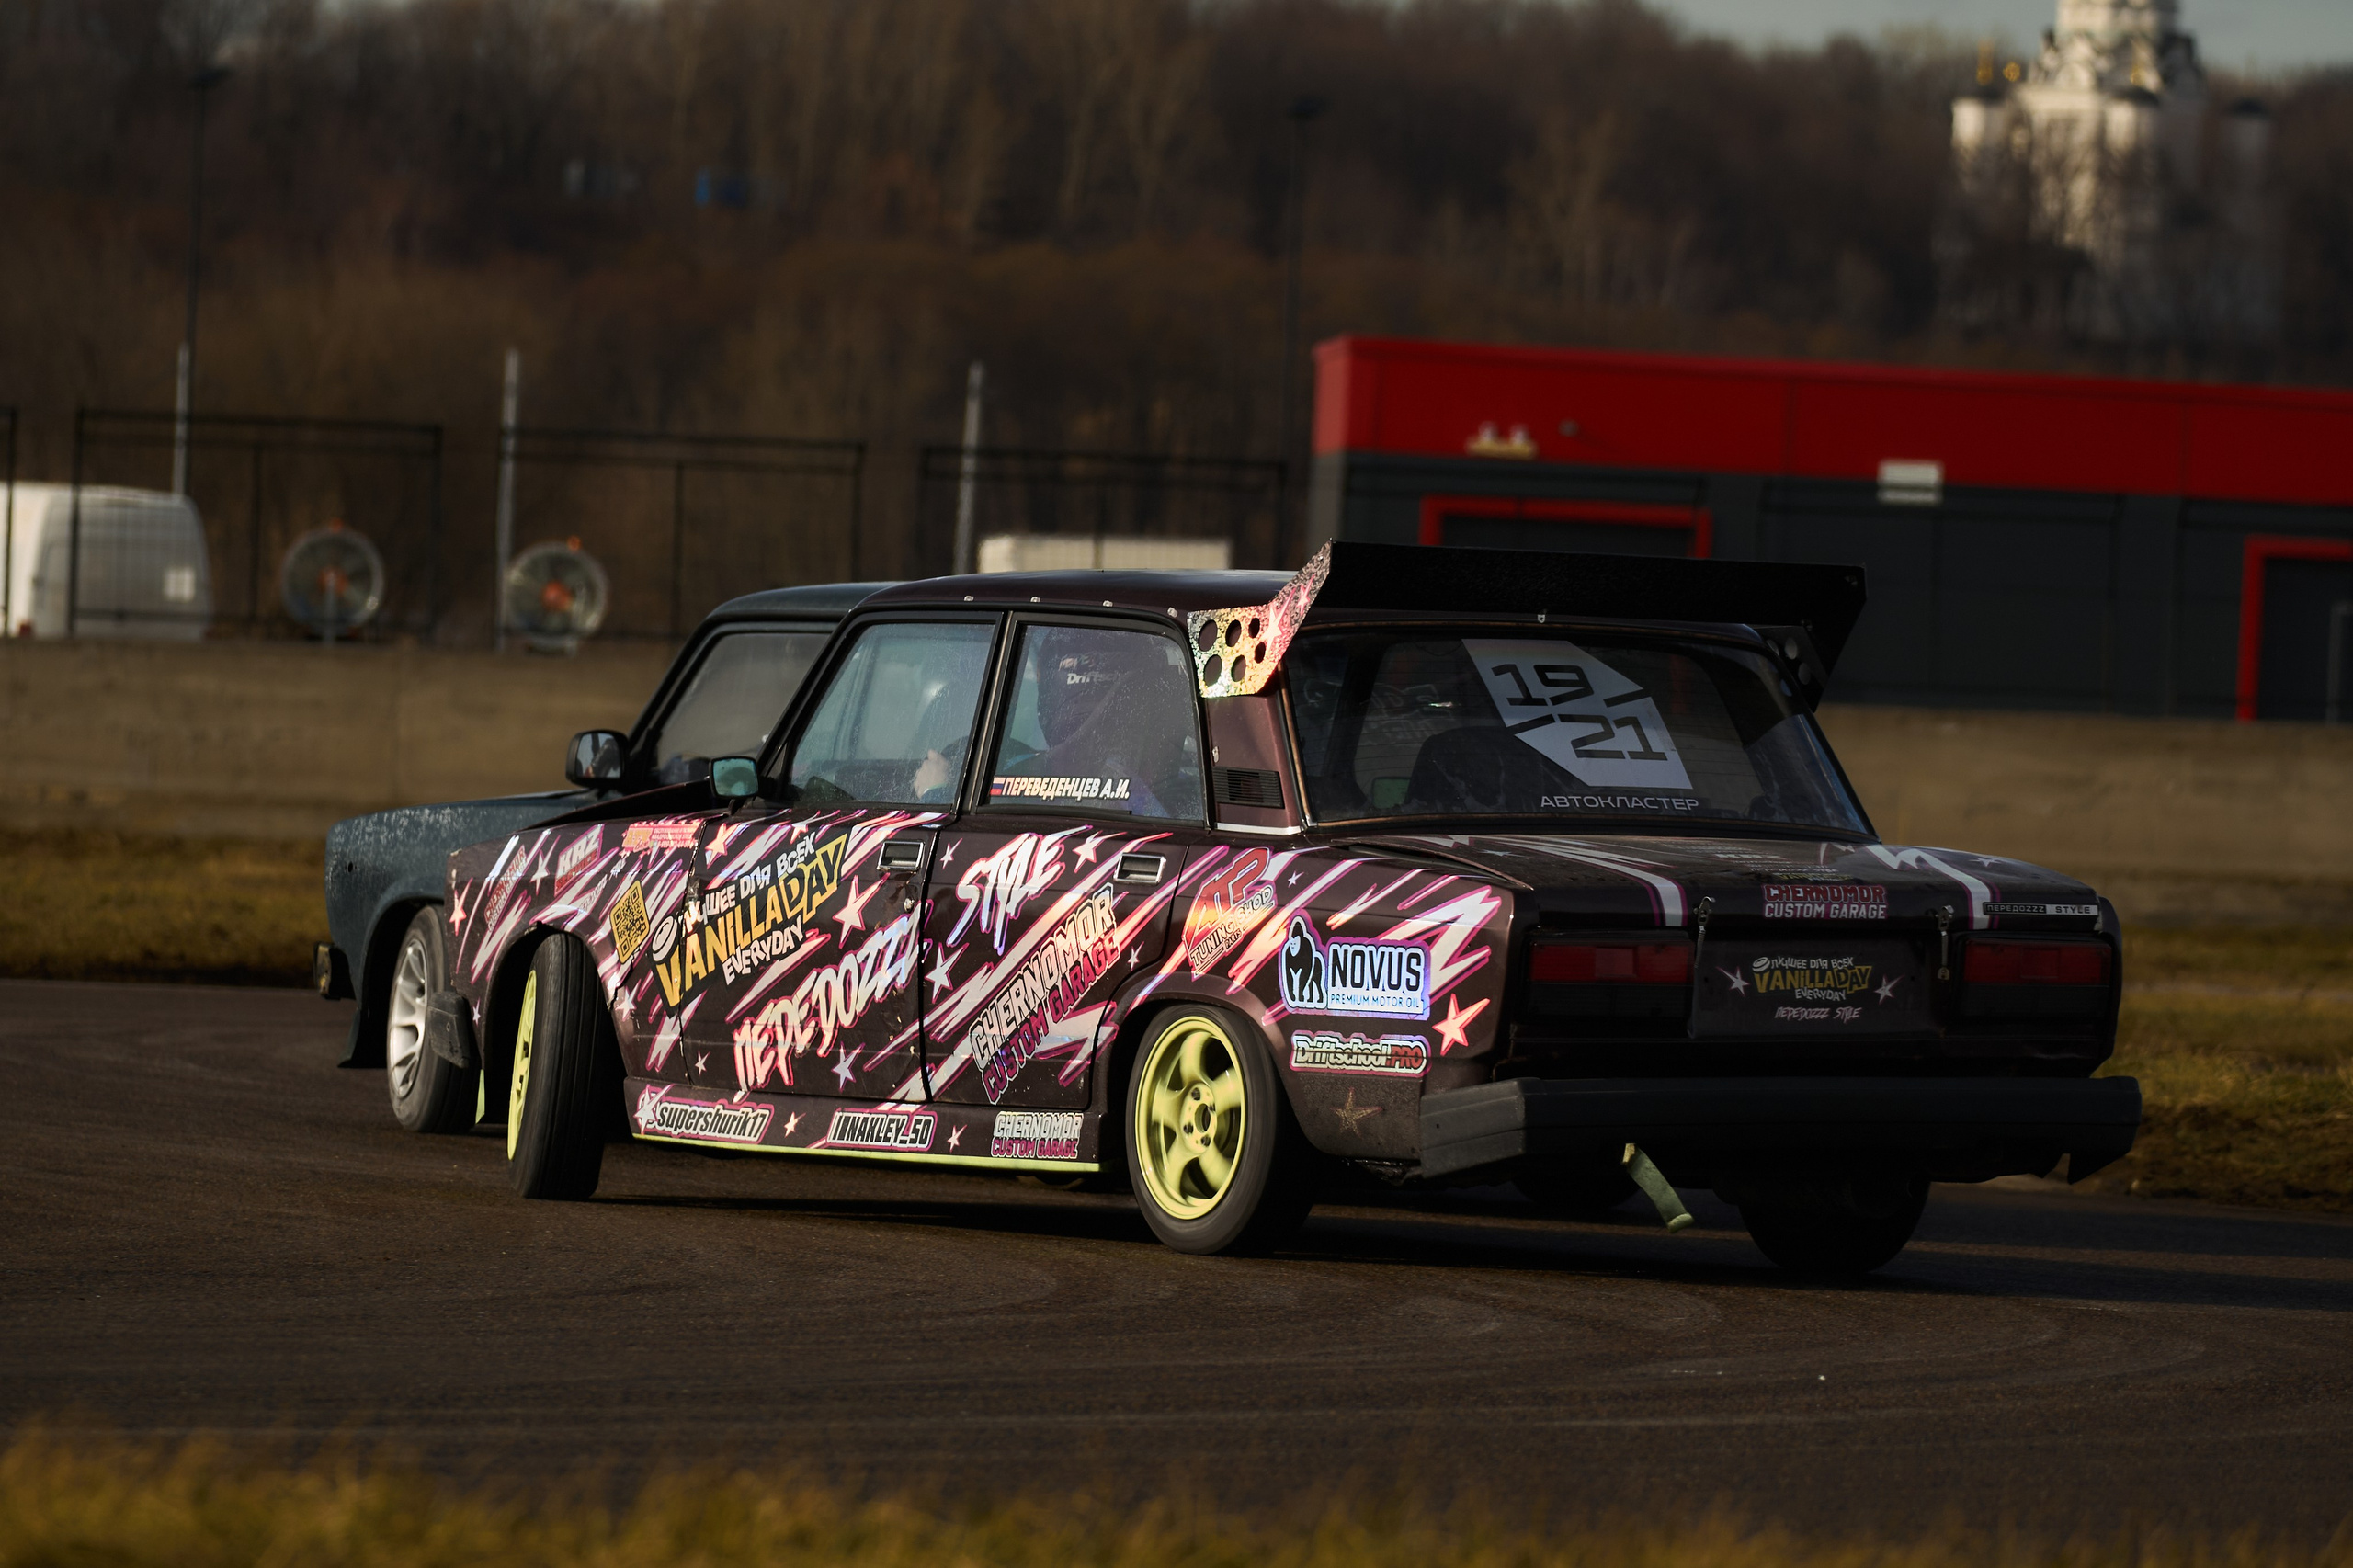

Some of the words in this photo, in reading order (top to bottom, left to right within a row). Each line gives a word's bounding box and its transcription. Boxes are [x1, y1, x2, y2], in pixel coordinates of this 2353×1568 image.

[1491, 664, 1594, 706] 19
[1558, 713, 1668, 761] 21
[1002, 777, 1100, 801] ПЕРЕВЕДЕНЦЕВ
[1099, 778, 1131, 799] А.И.
[1540, 795, 1699, 811] АВТОКЛАСТЕР
[1765, 884, 1885, 903] CHERNOMOR
[1765, 903, 1825, 919] CUSTOM
[1829, 904, 1887, 920] GARAGE
[2055, 905, 2090, 914] STYLE
[1190, 918, 1235, 966] TUNING
[1235, 885, 1273, 922] SHOP
[723, 915, 804, 985] EVERYDAY
[1331, 948, 1422, 992] NOVUS
[1831, 956, 1855, 970] ВСЕХ
[970, 884, 1115, 1068] CHERNOMOR
[1330, 994, 1370, 1006] PREMIUM
[1371, 995, 1404, 1007] MOTOR
[1405, 997, 1420, 1008] OIL
[1794, 986, 1847, 1002] EVERYDAY
[983, 1009, 1049, 1103] CUSTOM
[1048, 930, 1120, 1024] GARAGE
[994, 1112, 1083, 1138] CHERNOMOR
[992, 1138, 1036, 1156] CUSTOM
[1037, 1139, 1078, 1158] GARAGE
